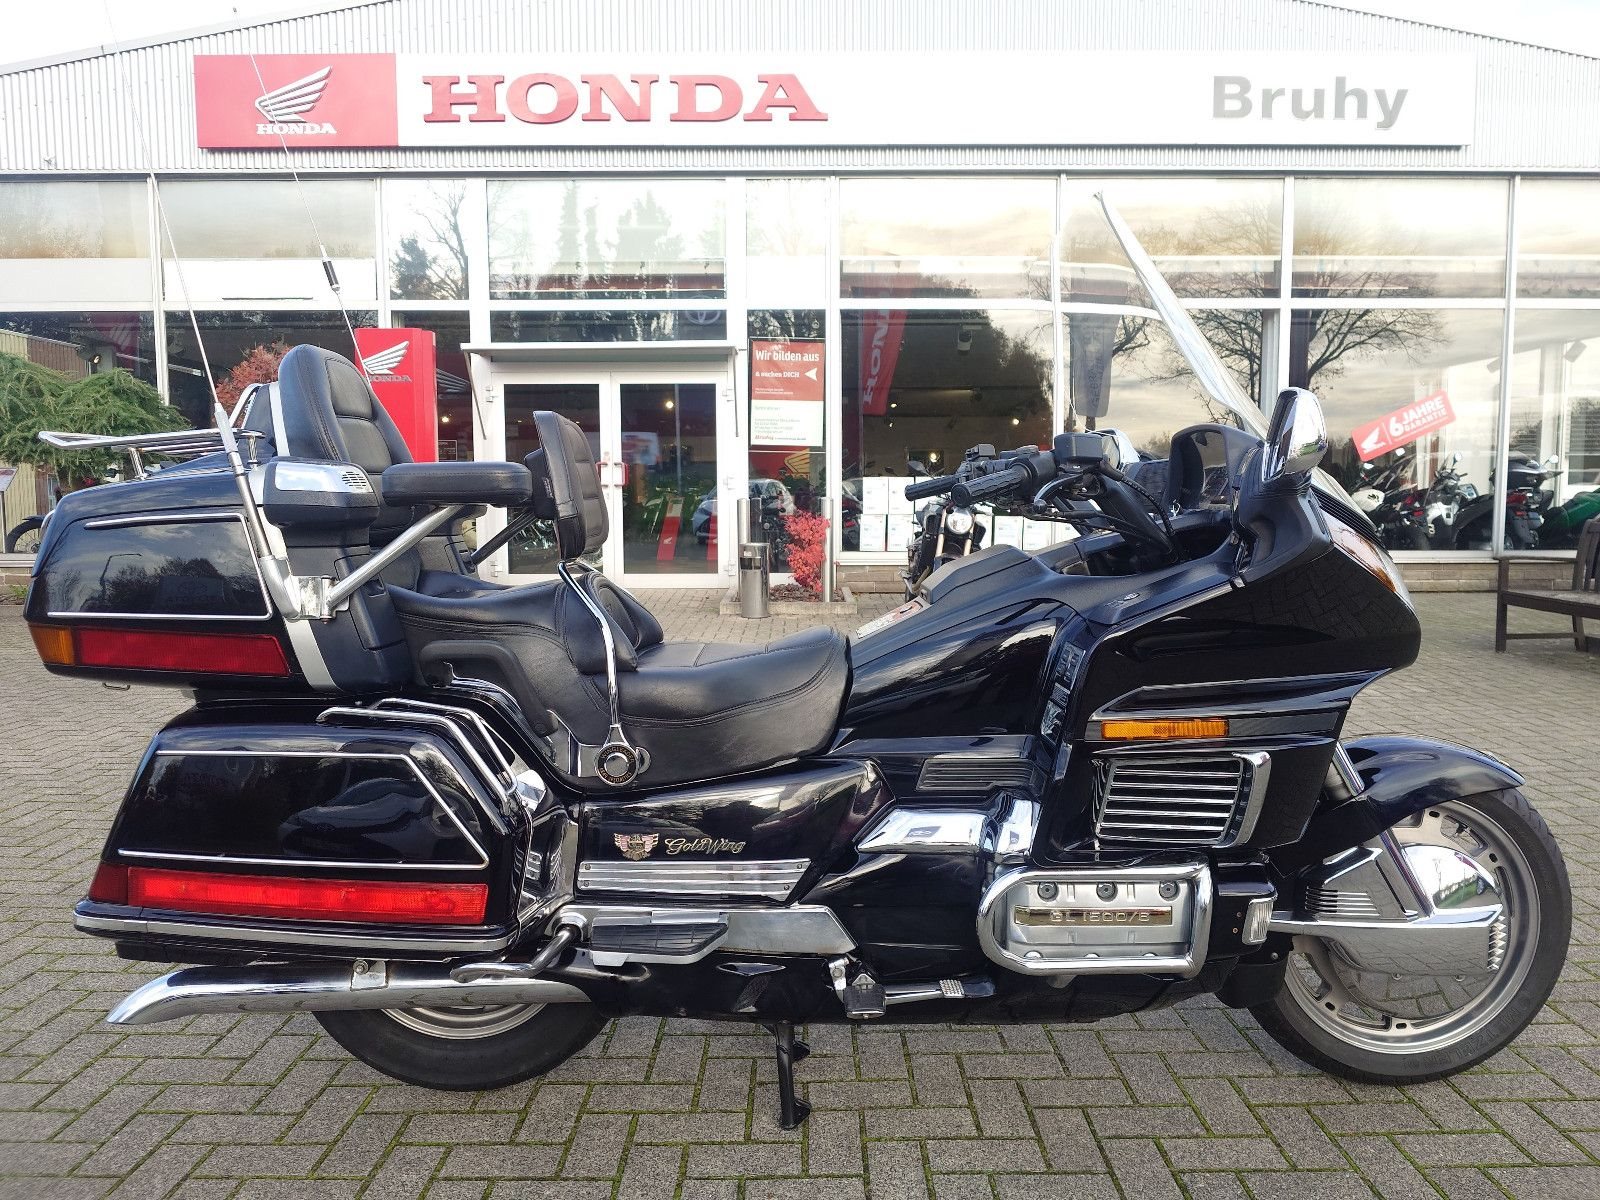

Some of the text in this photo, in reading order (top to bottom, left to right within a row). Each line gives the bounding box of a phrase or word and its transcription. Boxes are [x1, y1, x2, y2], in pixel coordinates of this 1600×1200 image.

[422, 73, 828, 124] HONDA
[1212, 75, 1408, 129] Bruhy
[256, 122, 337, 134] HONDA
[755, 349, 820, 362] Wir bilden aus
[1389, 395, 1444, 437] 6 JAHRE
[1403, 407, 1447, 432] GARANTIE
[664, 837, 747, 856] GoldWing
[1050, 909, 1076, 922] GL
